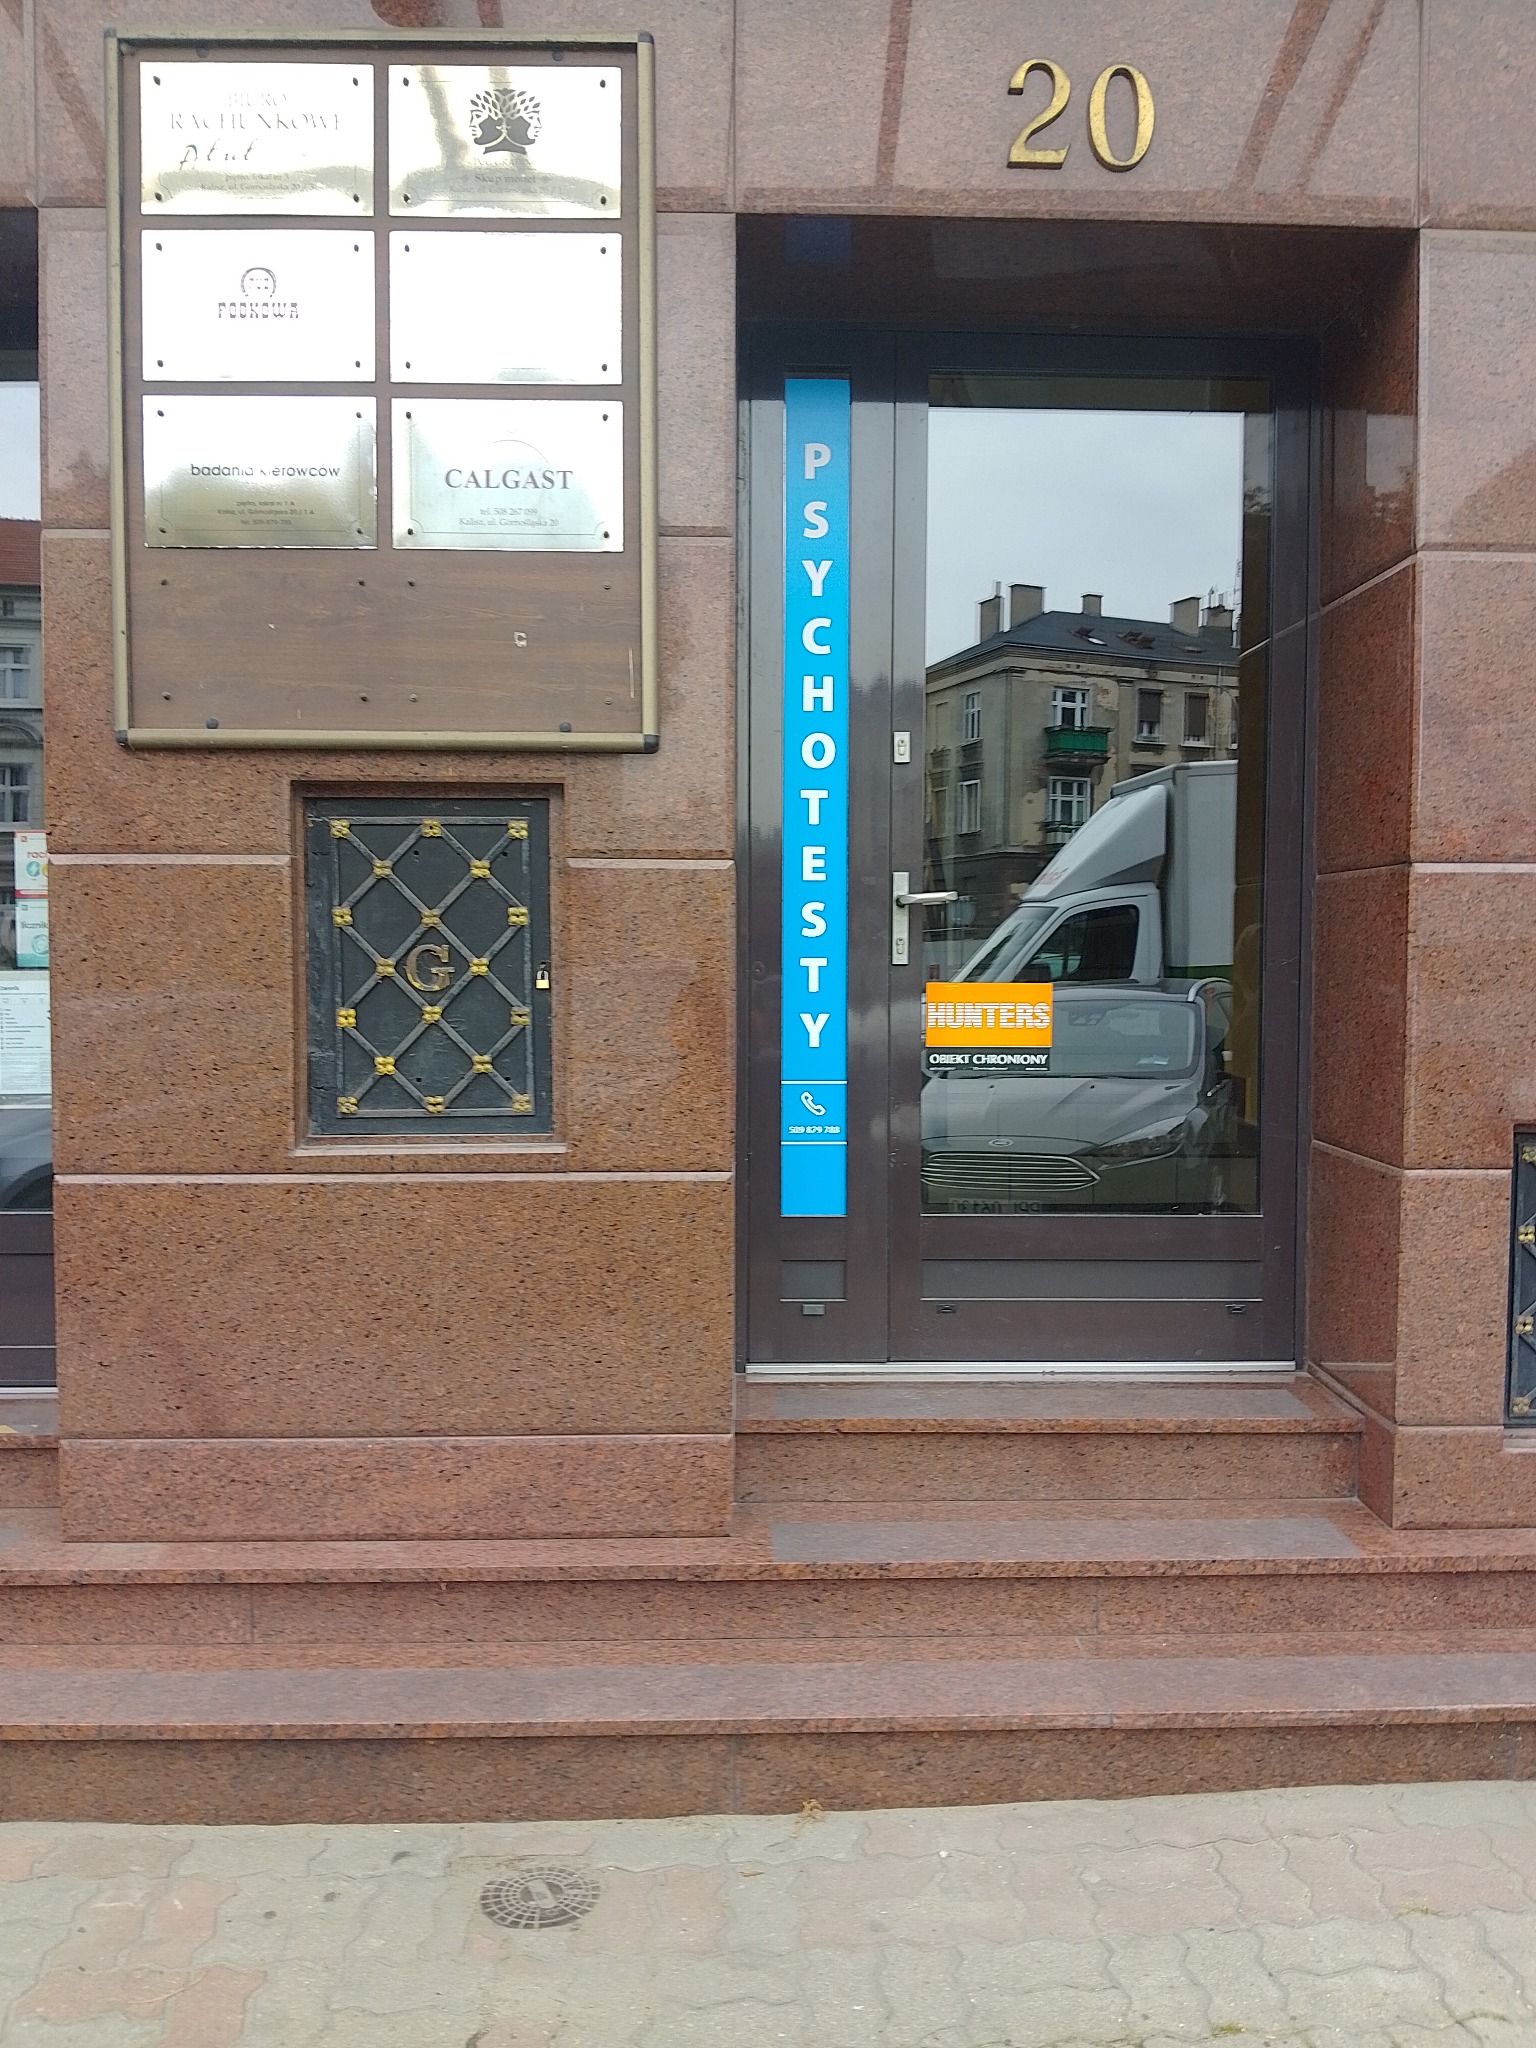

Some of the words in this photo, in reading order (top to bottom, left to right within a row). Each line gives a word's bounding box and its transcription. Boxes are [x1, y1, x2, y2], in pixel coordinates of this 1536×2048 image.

[1006, 57, 1155, 173] 20
[190, 463, 254, 477] badania
[444, 468, 574, 490] CALGAST
[799, 443, 837, 1049] PSYCHOTESTY
[404, 943, 456, 992] G
[927, 1002, 1051, 1029] HUNTERS
[929, 1053, 972, 1065] OBIEKT
[972, 1054, 1049, 1065] CHRONIONY
